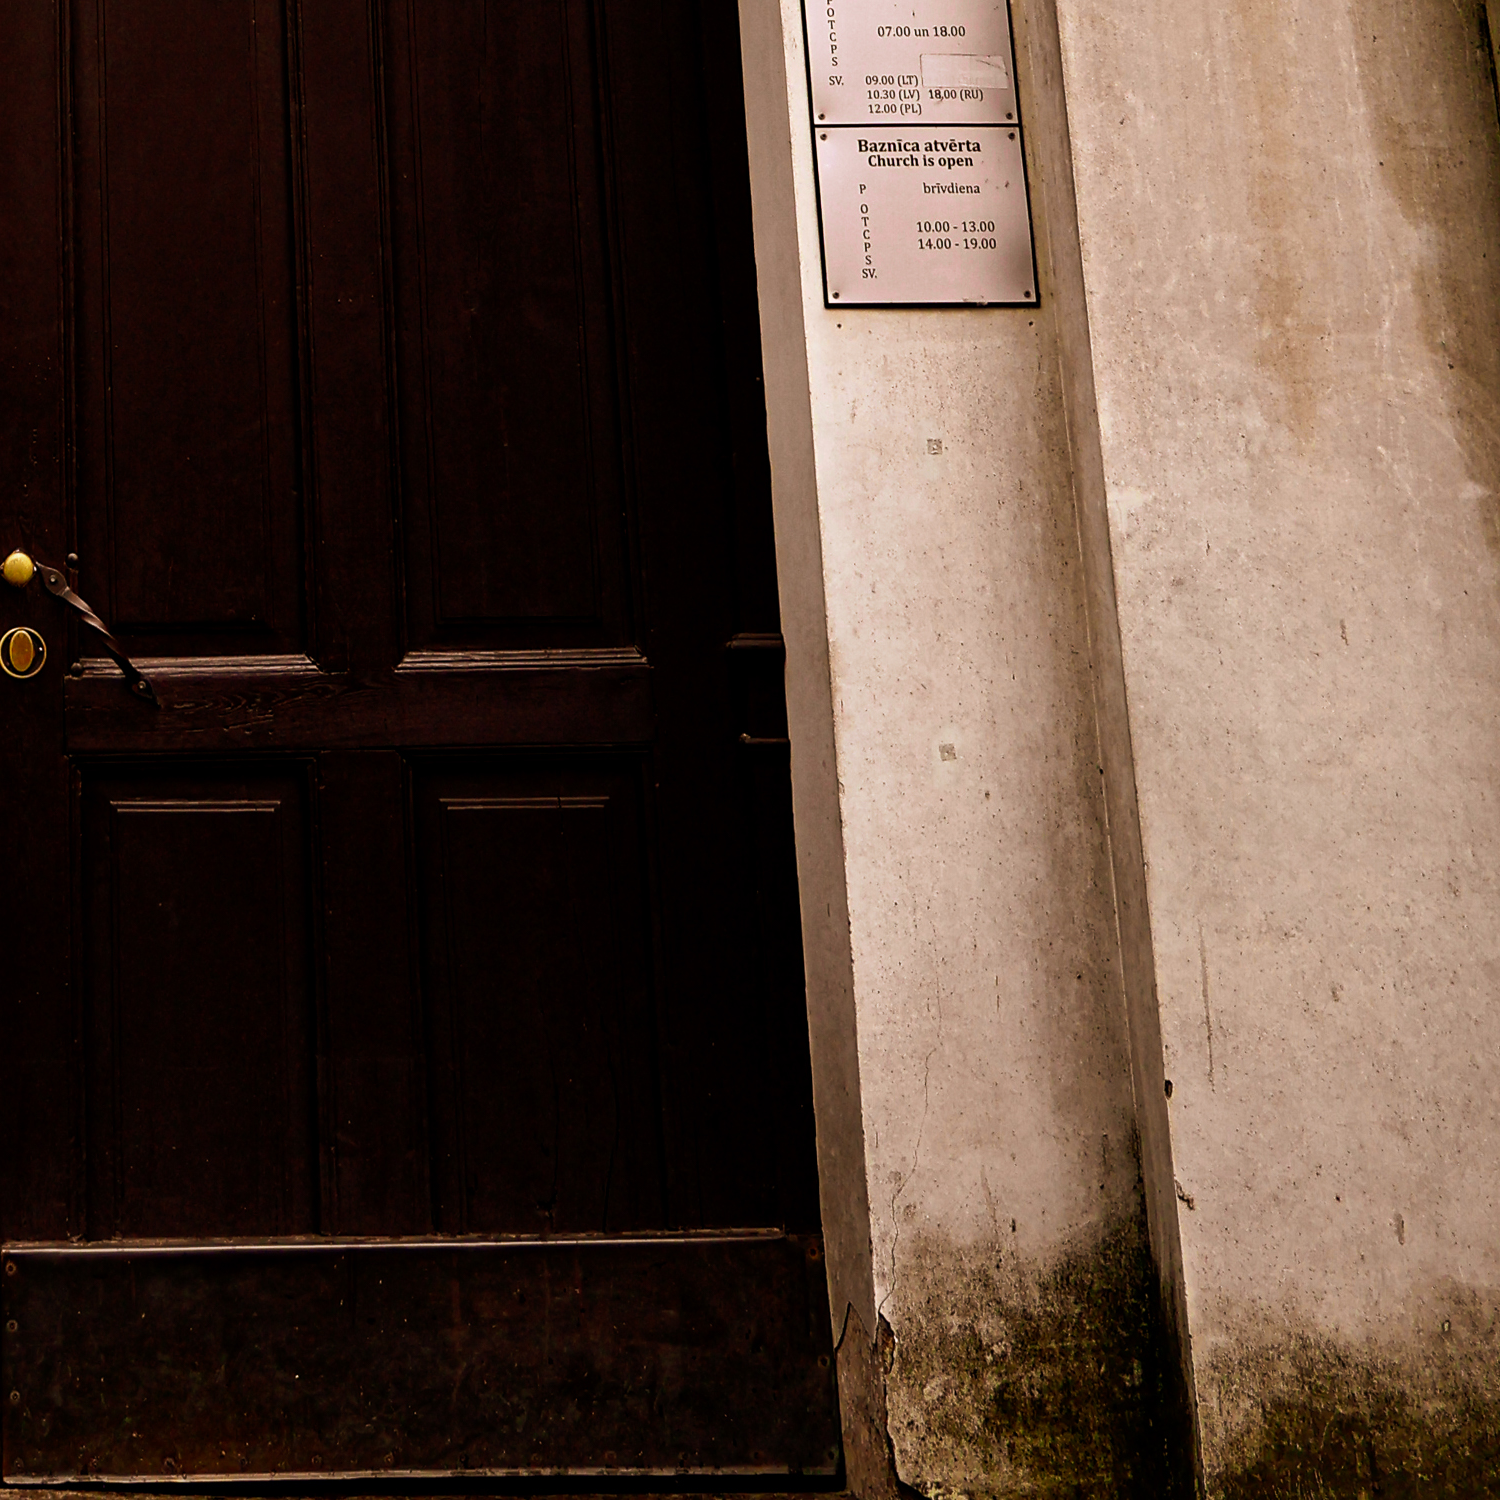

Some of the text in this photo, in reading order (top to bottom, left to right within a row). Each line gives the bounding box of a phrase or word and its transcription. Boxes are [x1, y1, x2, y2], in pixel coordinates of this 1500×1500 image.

[878, 26, 965, 37] 07.00 un 18.00
[829, 75, 918, 87] SV. 09.00 (LT)
[868, 90, 895, 99] 10.30
[899, 89, 920, 101] (LV)
[960, 89, 983, 101] (RU)
[869, 104, 921, 115] 12.00 (PL)
[858, 139, 981, 152] Baznīca atvērta
[868, 154, 973, 169] Church is open
[923, 182, 980, 193] brīvdiena
[917, 221, 949, 232] 10.00
[962, 221, 995, 232] 13.00
[918, 238, 951, 249] 14.00
[964, 238, 996, 249] 19.00
[862, 269, 878, 278] SV.
